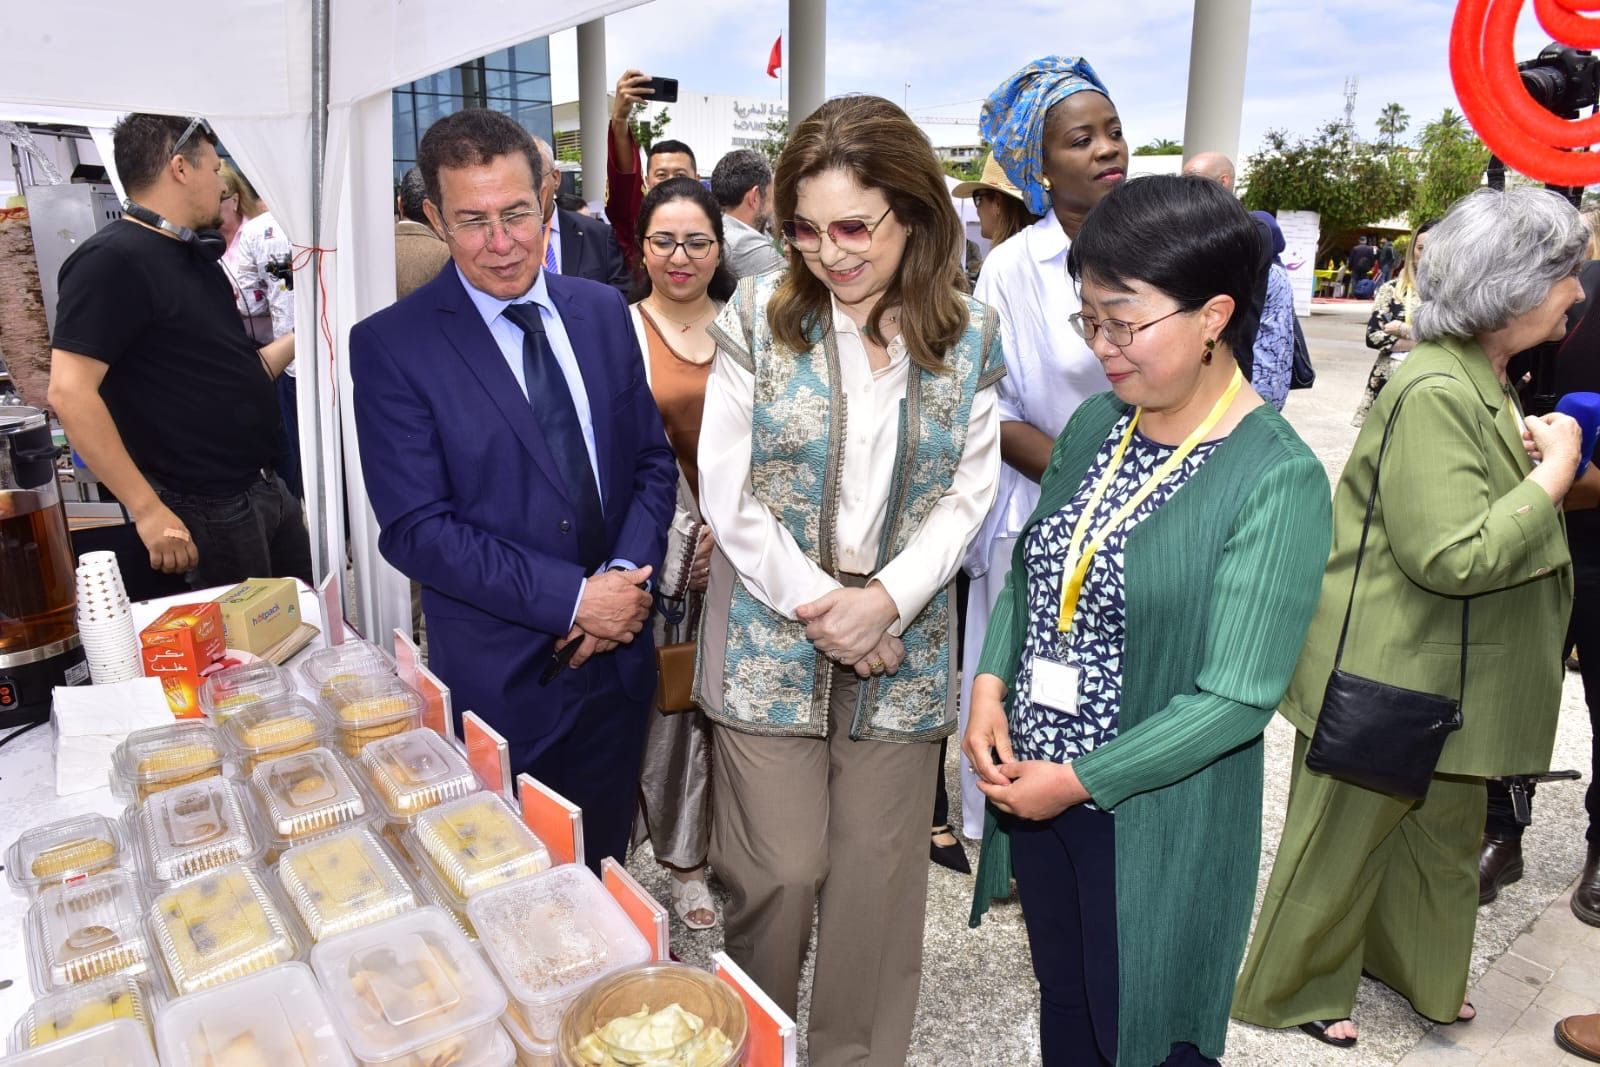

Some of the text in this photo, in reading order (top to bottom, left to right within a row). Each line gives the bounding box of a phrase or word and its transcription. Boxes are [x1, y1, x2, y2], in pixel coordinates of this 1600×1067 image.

[252, 602, 280, 627] hotpack
[146, 649, 185, 663] سكر
[151, 661, 189, 672] مغلف
